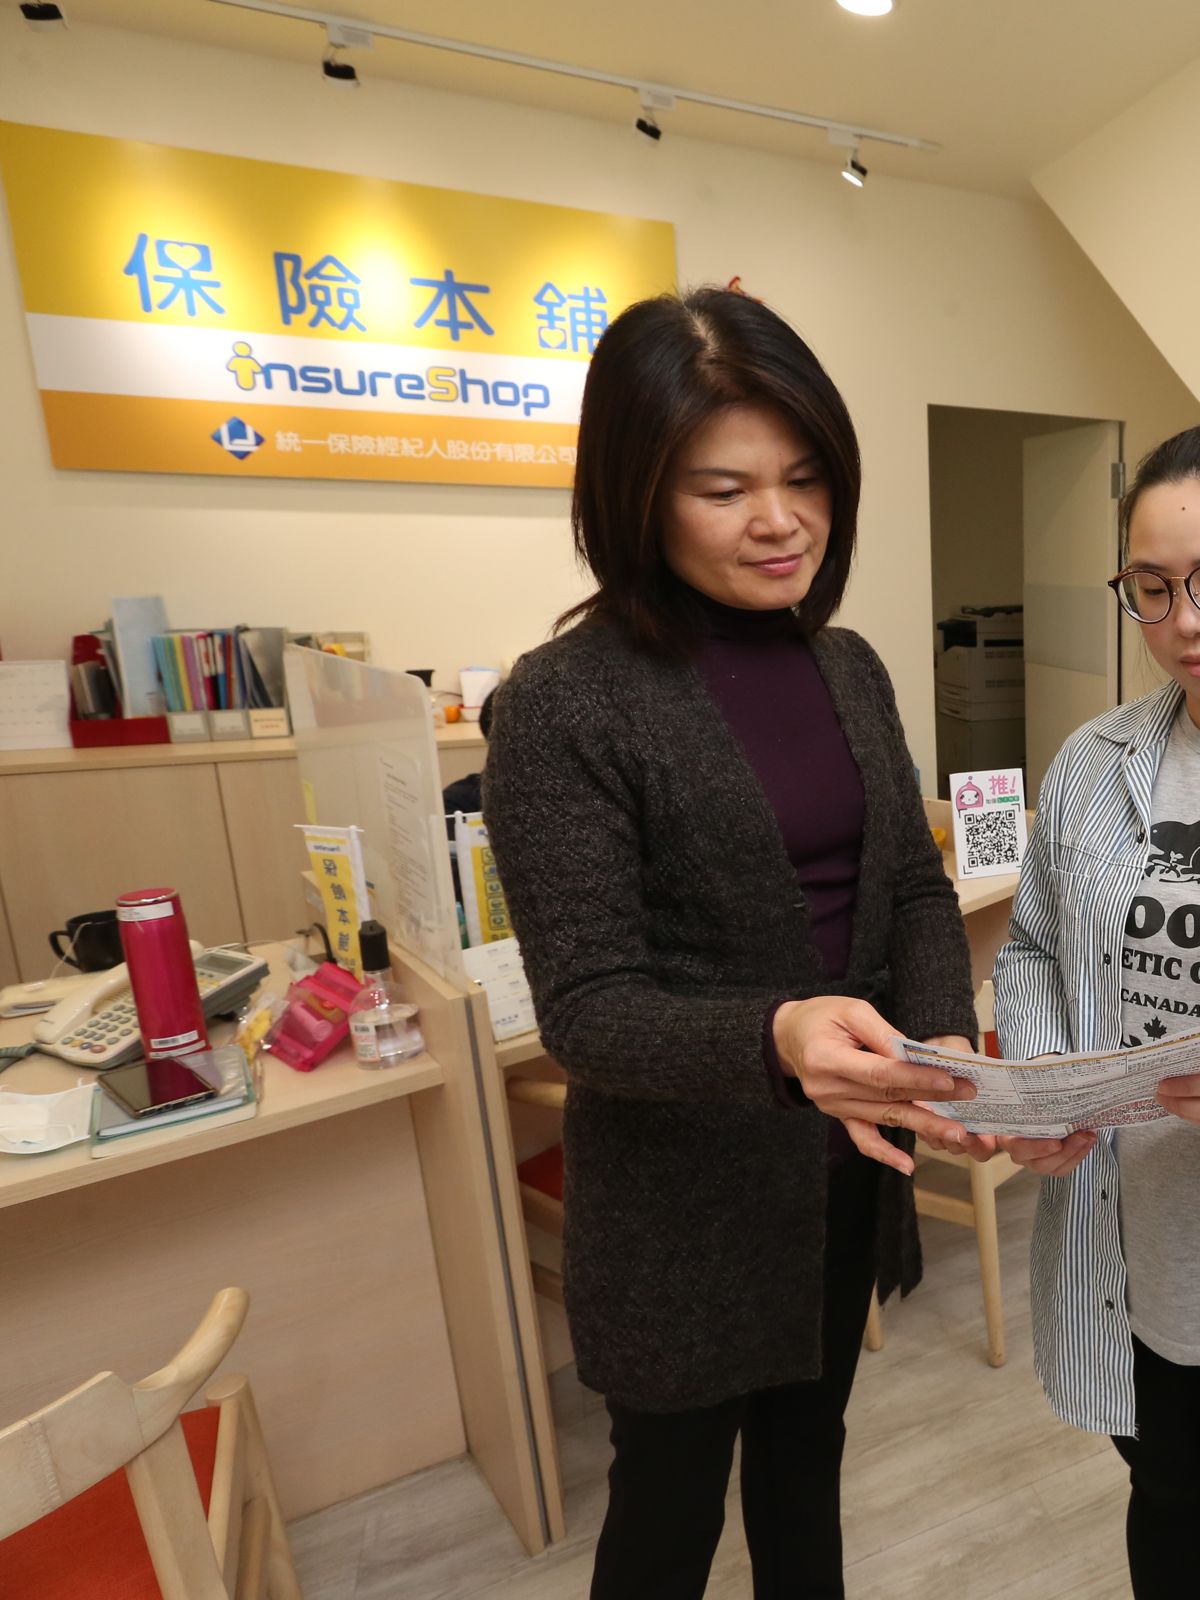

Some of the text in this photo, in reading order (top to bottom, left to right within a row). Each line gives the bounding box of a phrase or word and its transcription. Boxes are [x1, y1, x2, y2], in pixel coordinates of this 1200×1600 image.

[123, 233, 608, 352] 保險本舖
[227, 340, 550, 416] insureShop
[274, 431, 577, 465] 統一保險經紀人股份有限公司
